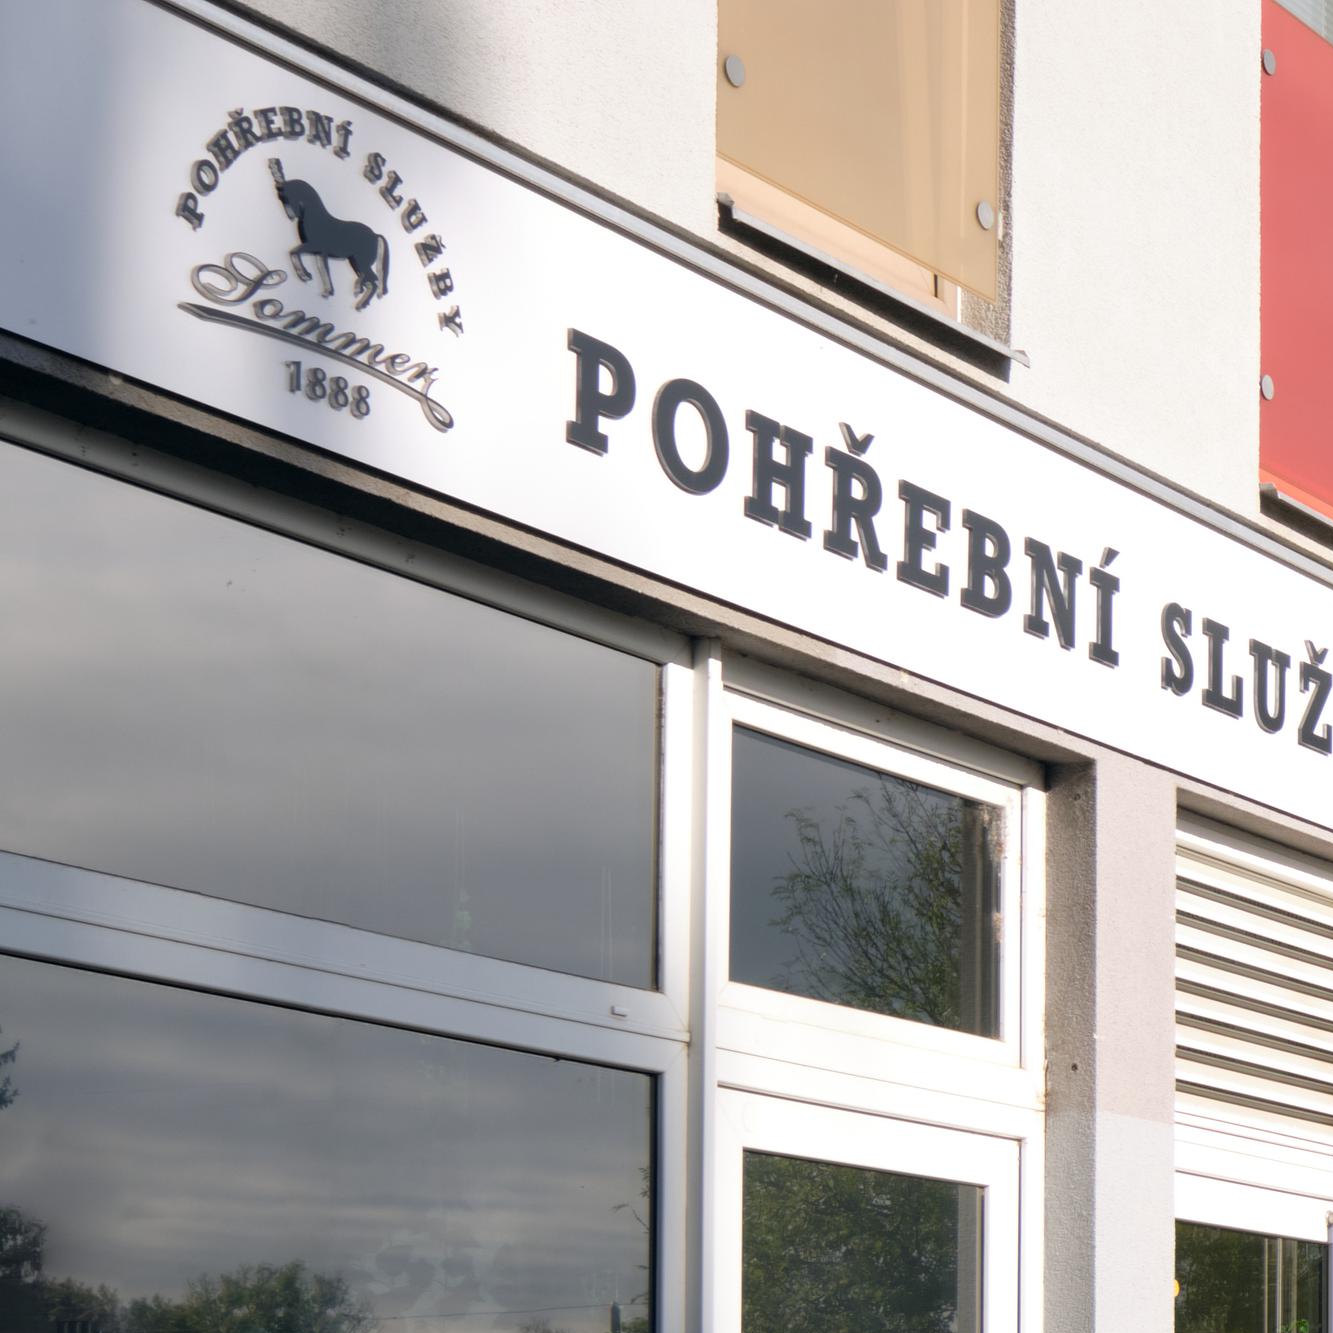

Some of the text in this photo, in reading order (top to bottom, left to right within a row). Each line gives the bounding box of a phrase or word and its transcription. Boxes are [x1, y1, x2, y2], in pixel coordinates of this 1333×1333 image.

[175, 106, 464, 338] POHŘEBNÍ SLUŽBY
[284, 359, 371, 420] 1888
[566, 327, 1121, 669] POHŘEBNÍ
